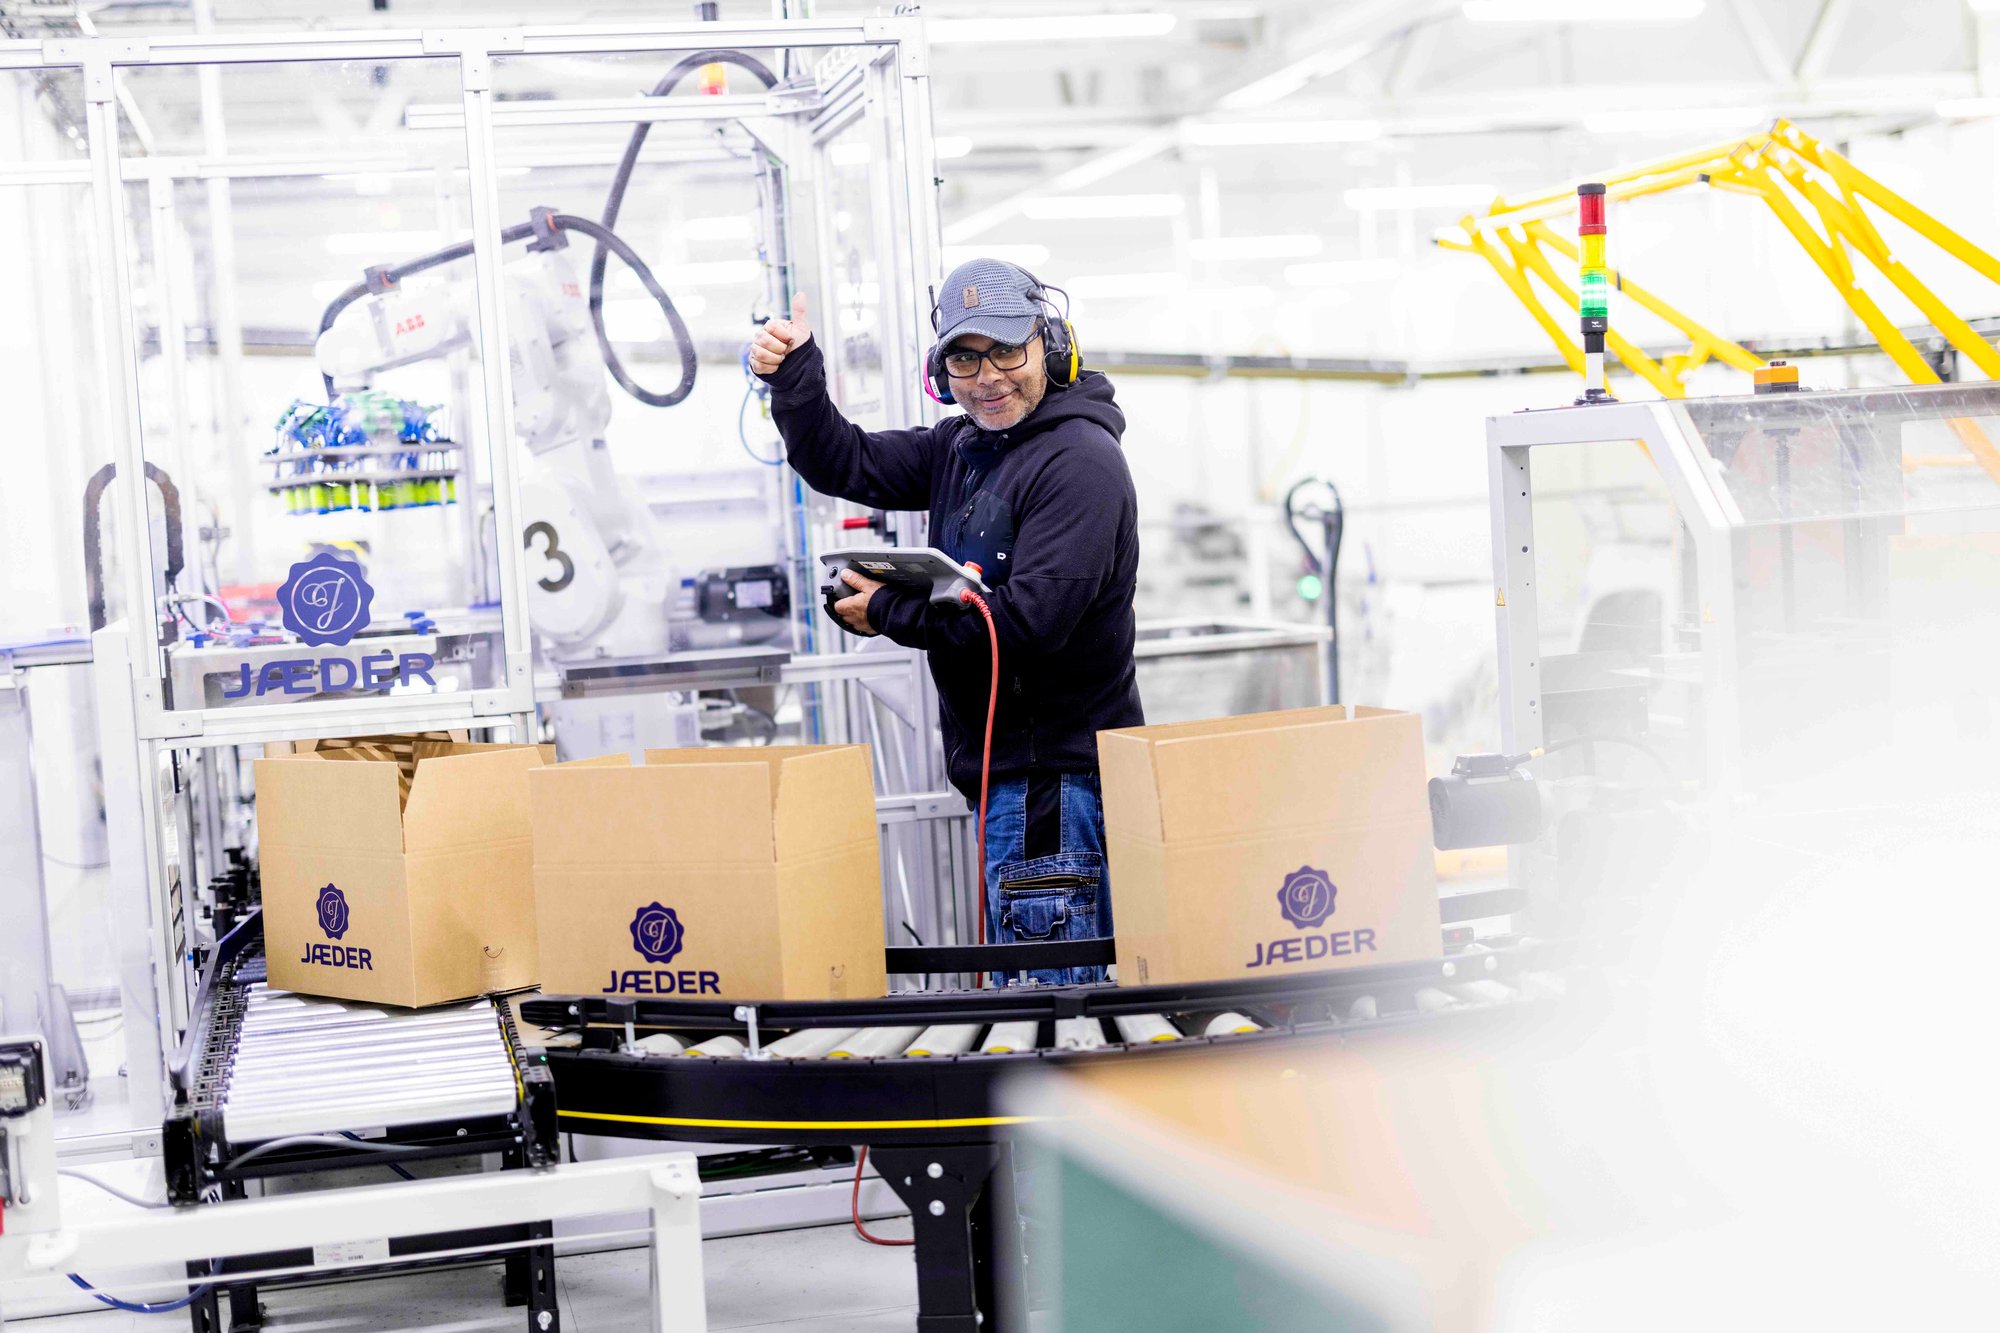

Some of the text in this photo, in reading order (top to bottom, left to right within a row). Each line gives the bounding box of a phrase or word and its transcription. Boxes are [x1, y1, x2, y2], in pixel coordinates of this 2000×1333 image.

[395, 313, 425, 336] ABB
[523, 521, 575, 593] 3
[224, 652, 437, 698] JÆDER
[301, 942, 373, 971] JÆDER
[1246, 928, 1377, 968] JÆDER
[602, 970, 721, 994] JÆDER
